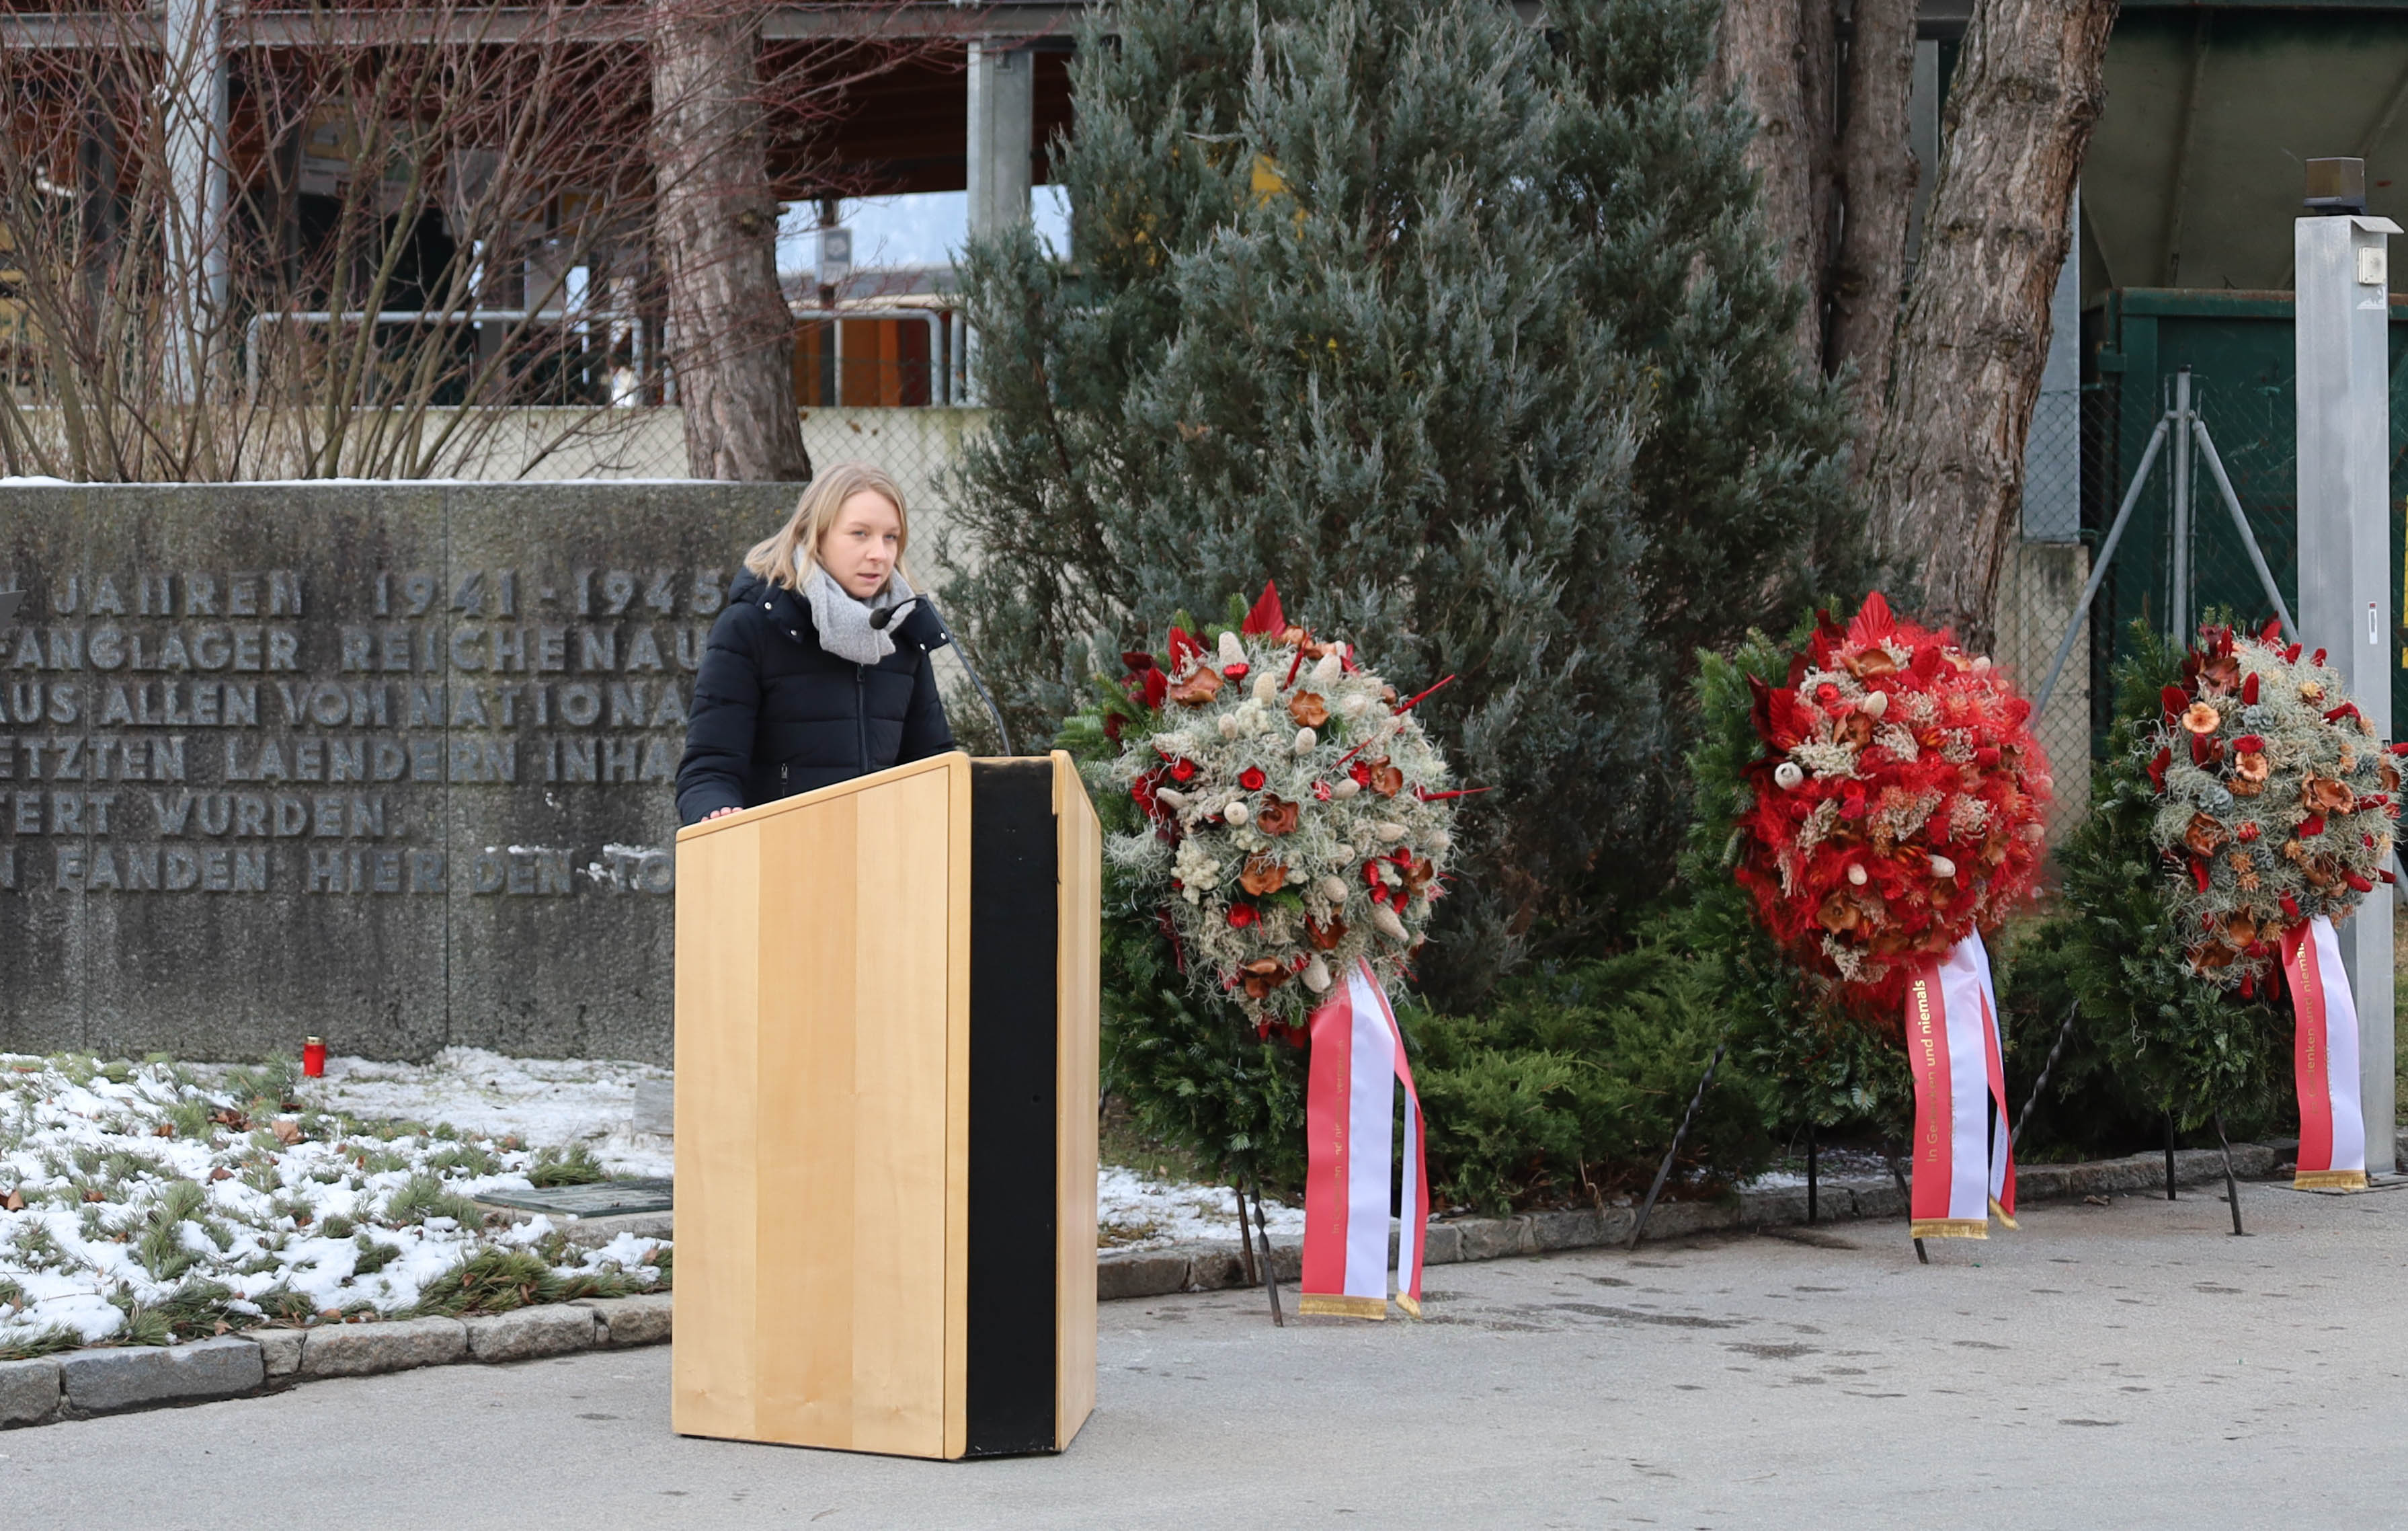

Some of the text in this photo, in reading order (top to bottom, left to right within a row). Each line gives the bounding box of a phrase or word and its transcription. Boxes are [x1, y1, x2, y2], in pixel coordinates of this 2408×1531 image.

[52, 572, 303, 615] JAHREN
[342, 625, 708, 671] REICHENAU
[0, 680, 78, 724] US
[99, 680, 259, 725] ALLEN
[276, 680, 389, 726] VOM
[225, 737, 517, 782] LAENDERN
[0, 790, 119, 834] ERT
[55, 843, 268, 891] FANDEN
[307, 846, 446, 894] HIER
[471, 847, 573, 895] DEN
[1912, 979, 1932, 1035] niemals
[2303, 996, 2313, 1023] und
[1921, 1038, 1936, 1067] und
[1926, 1148, 1937, 1163] In
